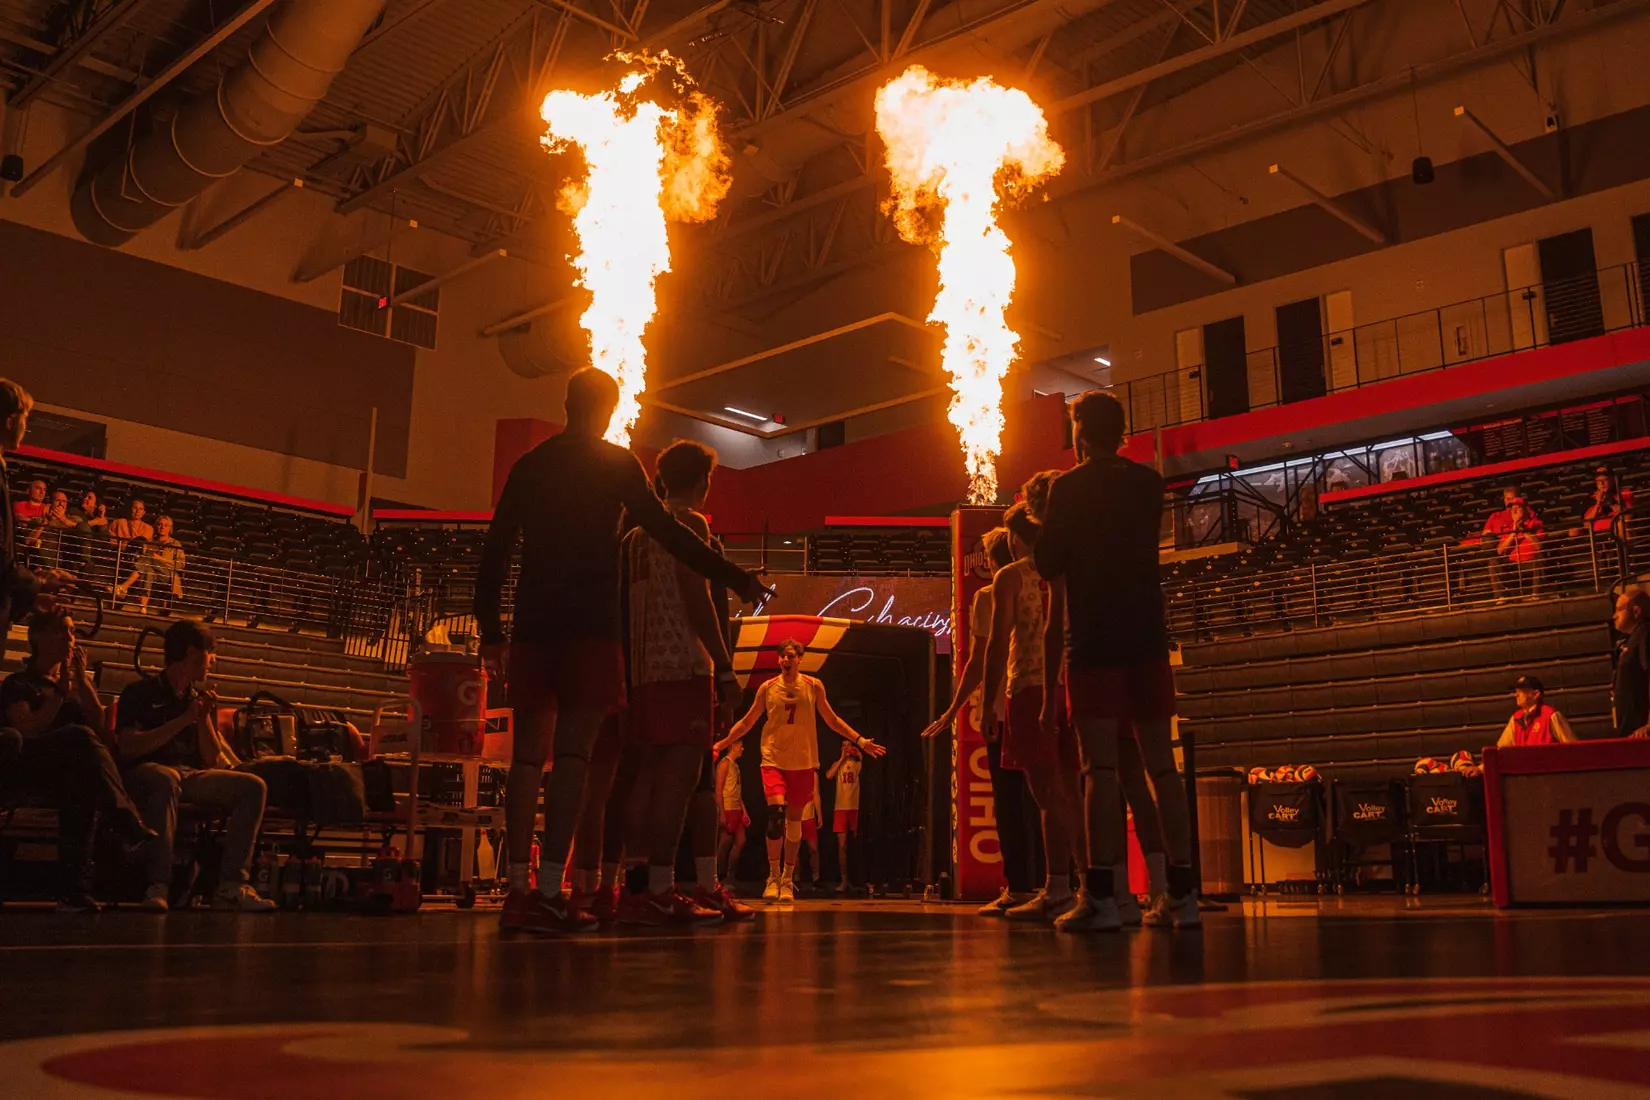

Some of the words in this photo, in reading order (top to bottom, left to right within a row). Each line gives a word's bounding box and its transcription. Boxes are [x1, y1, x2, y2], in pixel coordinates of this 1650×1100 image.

[785, 704, 796, 724] 7
[1273, 805, 1299, 815] Volley
[1426, 805, 1453, 814] CART
[1268, 812, 1296, 820] CART
[1353, 811, 1382, 819] CART
